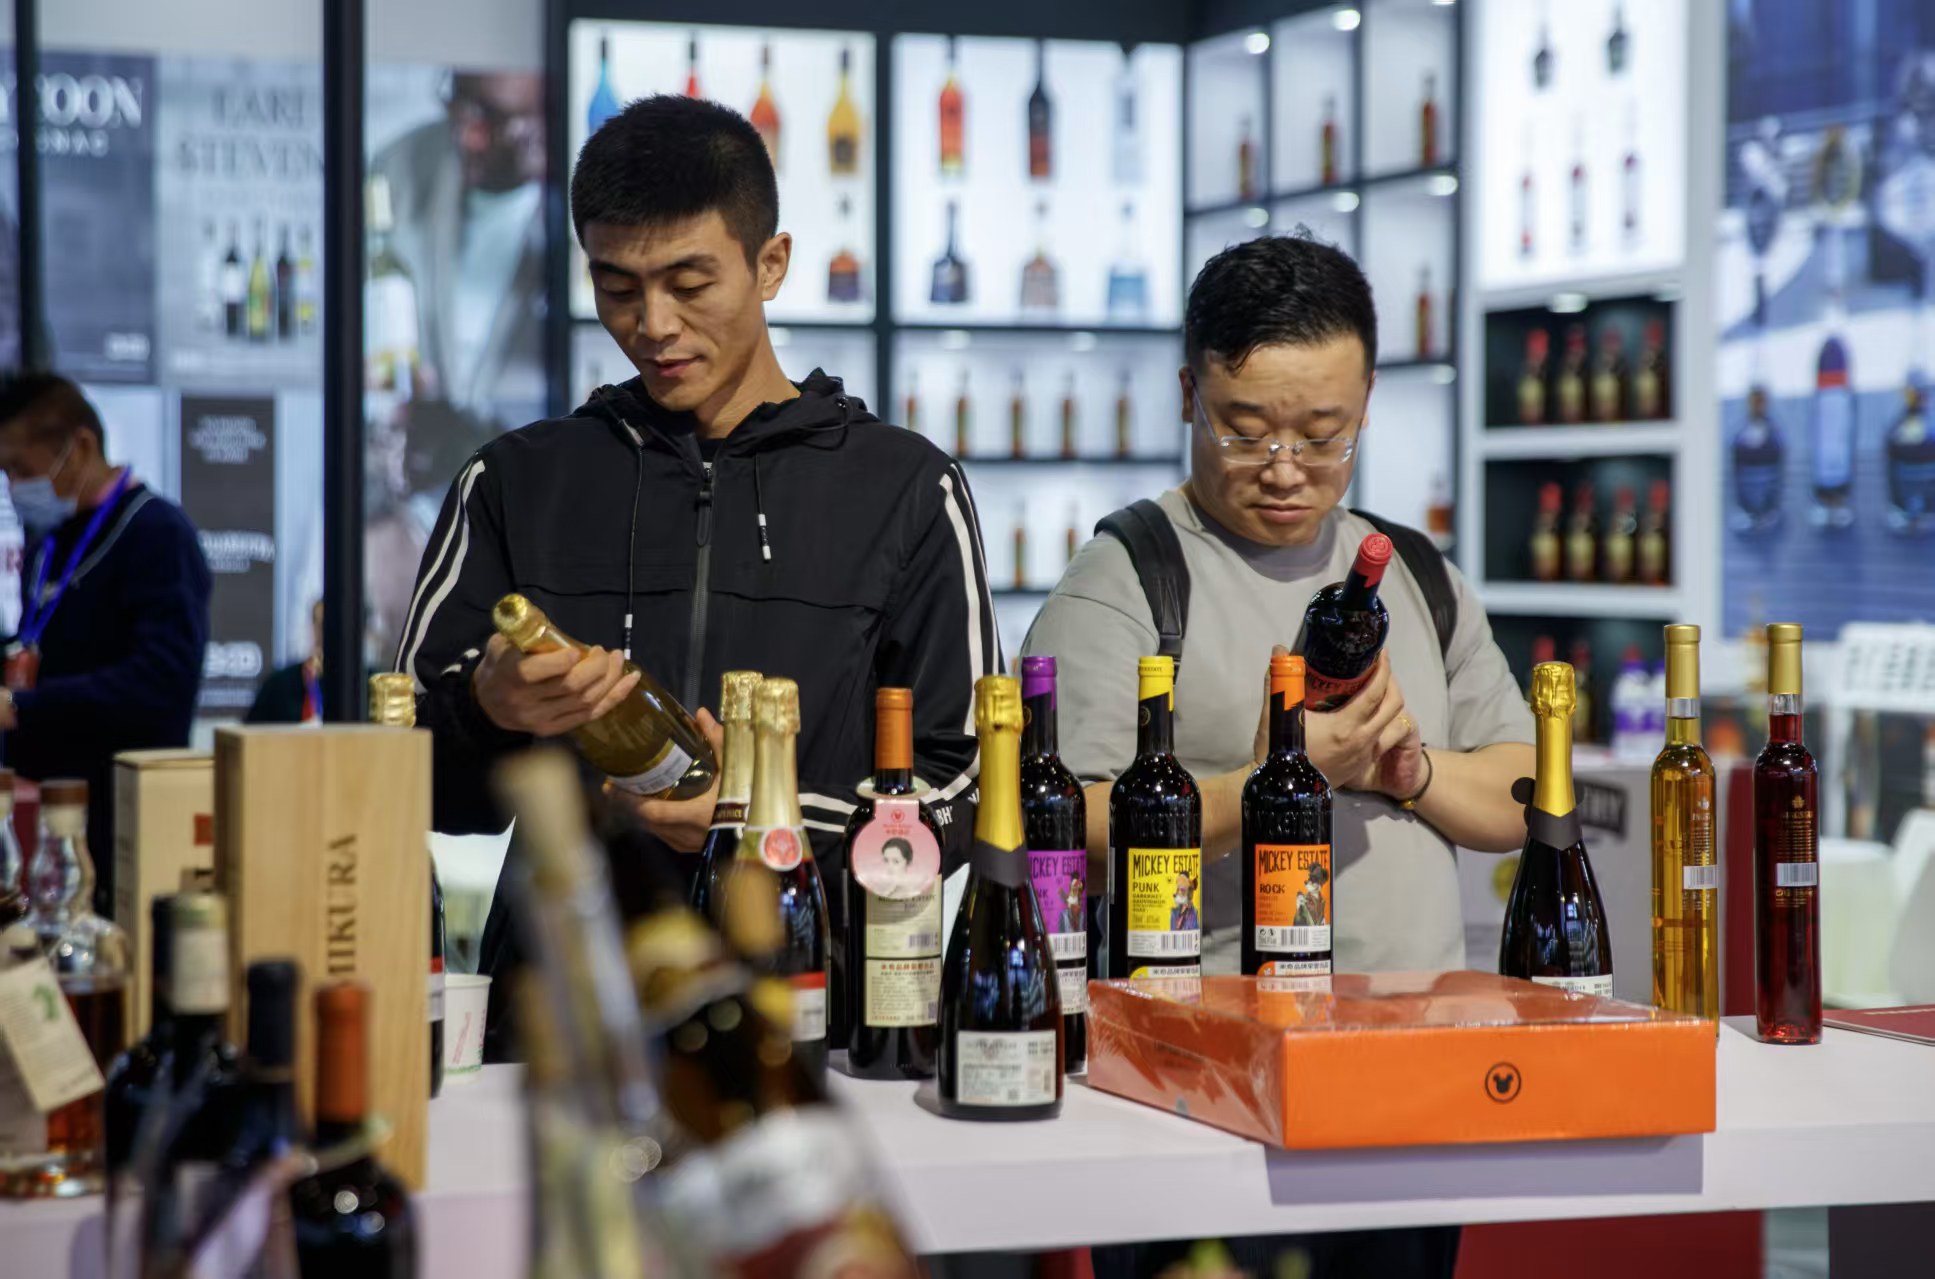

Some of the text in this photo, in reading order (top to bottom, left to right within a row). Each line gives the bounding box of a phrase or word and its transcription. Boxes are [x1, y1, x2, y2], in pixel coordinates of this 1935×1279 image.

[35, 72, 142, 128] OON
[1133, 854, 1170, 879] MICKEY
[1259, 849, 1293, 877] MICKEY
[1132, 882, 1160, 893] PUNK
[1260, 883, 1285, 894] ROCK
